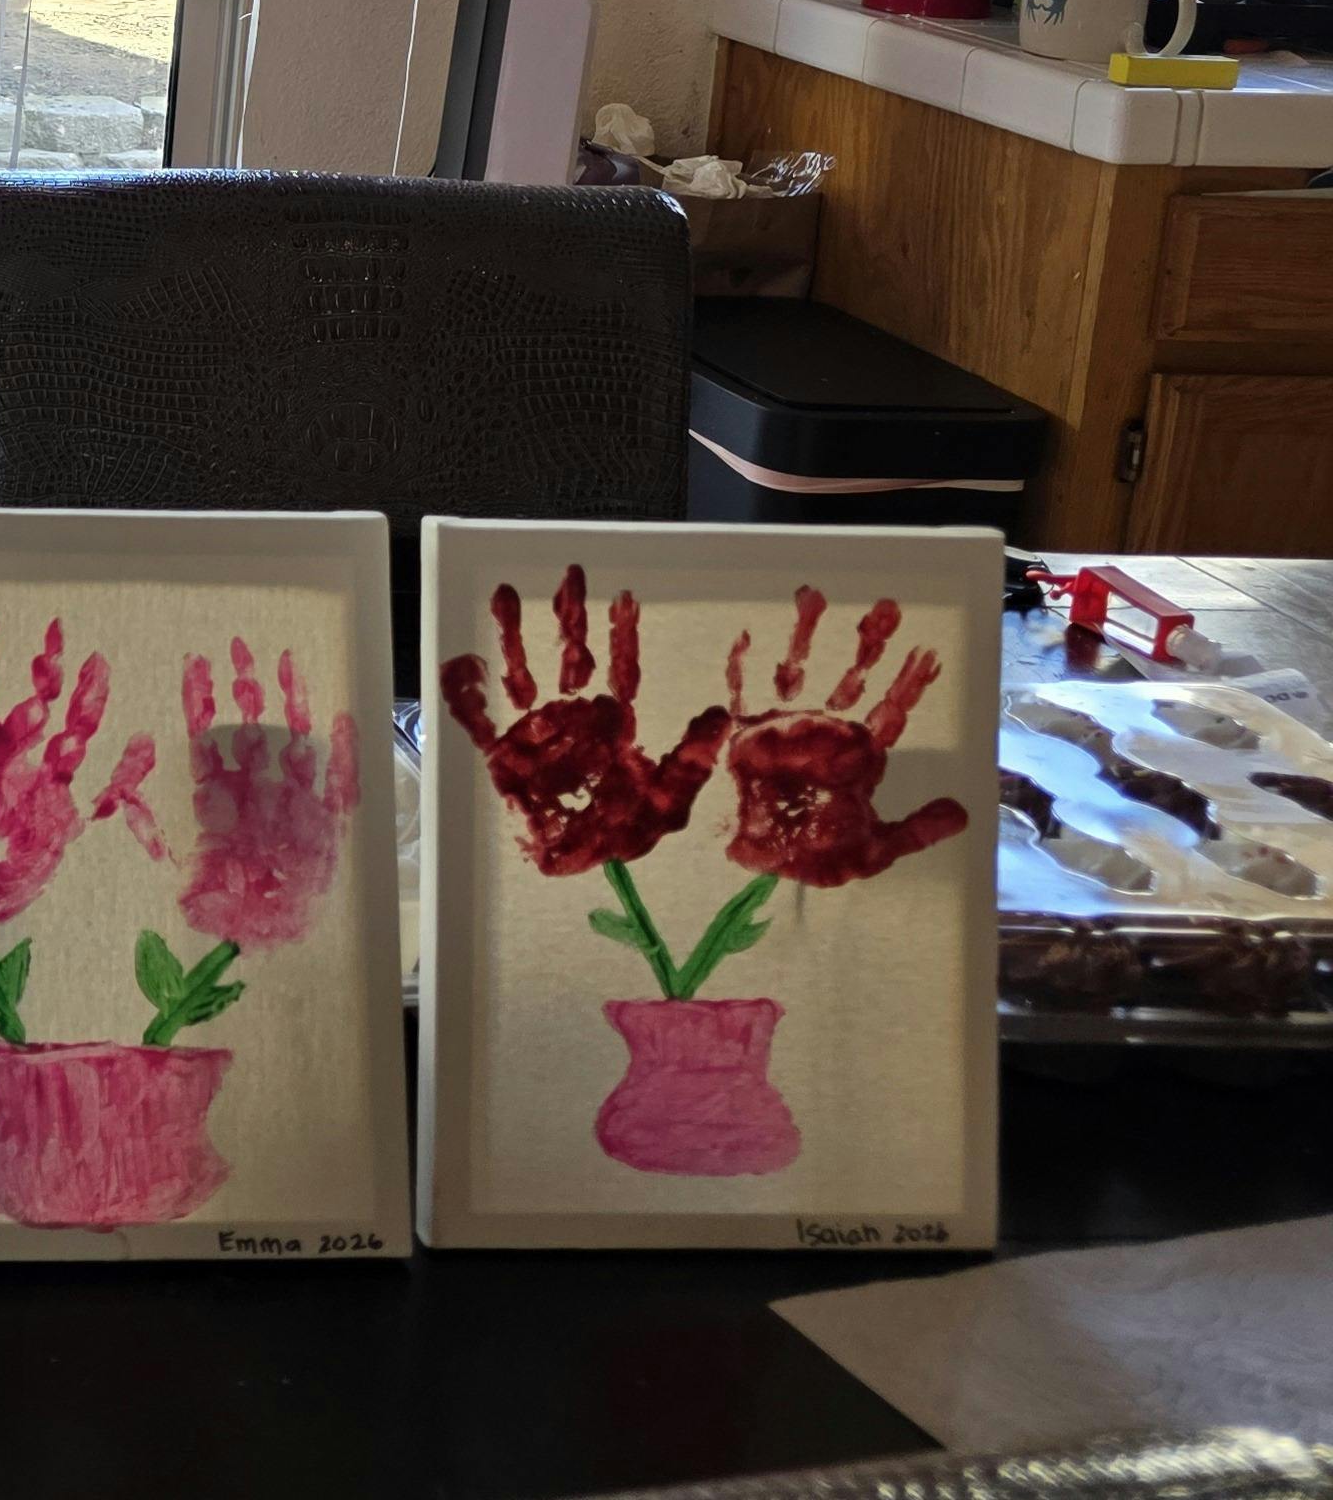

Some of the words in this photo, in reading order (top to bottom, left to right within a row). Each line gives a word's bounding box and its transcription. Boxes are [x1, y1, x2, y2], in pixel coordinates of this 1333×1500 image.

[218, 1231, 301, 1255] Emma
[318, 1233, 383, 1253] 2026
[796, 1218, 881, 1246] Isaiah
[893, 1221, 950, 1244] 2026
